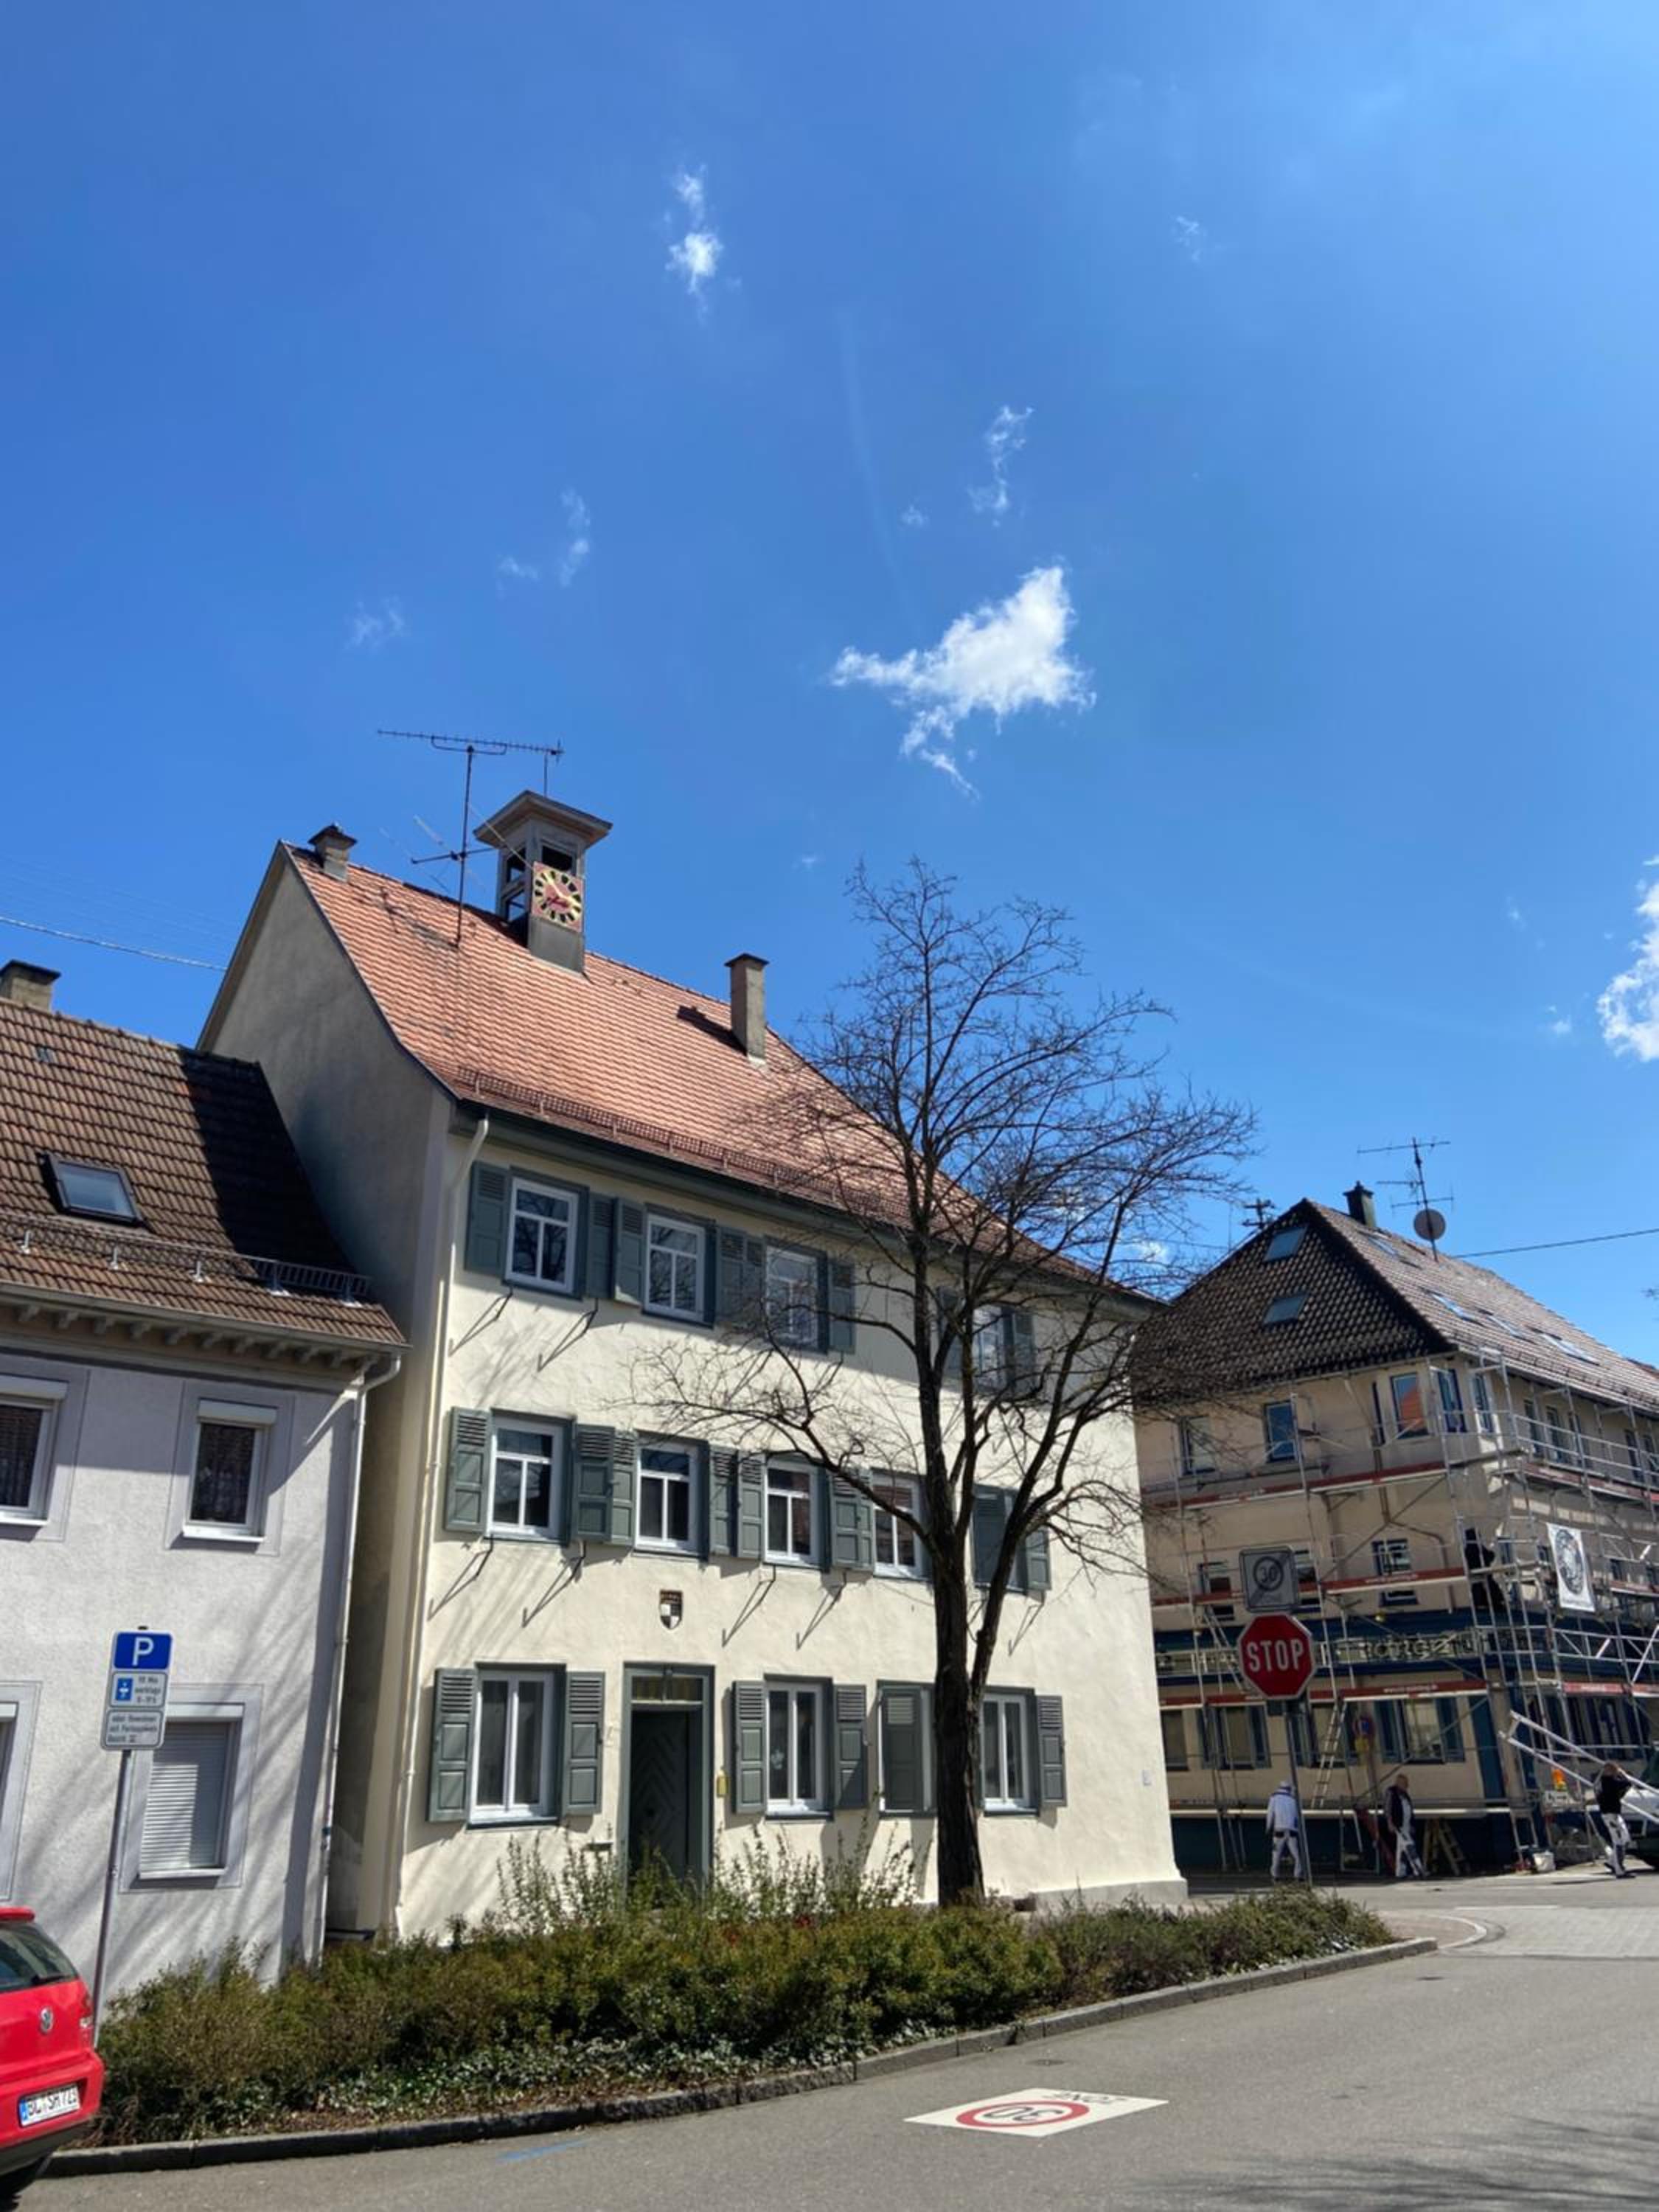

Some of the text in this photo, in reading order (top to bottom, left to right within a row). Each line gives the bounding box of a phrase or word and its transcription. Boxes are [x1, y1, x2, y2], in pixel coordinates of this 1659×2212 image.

[1259, 1563, 1279, 1583] 30
[131, 1636, 154, 1667] P
[1246, 1638, 1304, 1672] STOP
[981, 2106, 1064, 2123] 30
